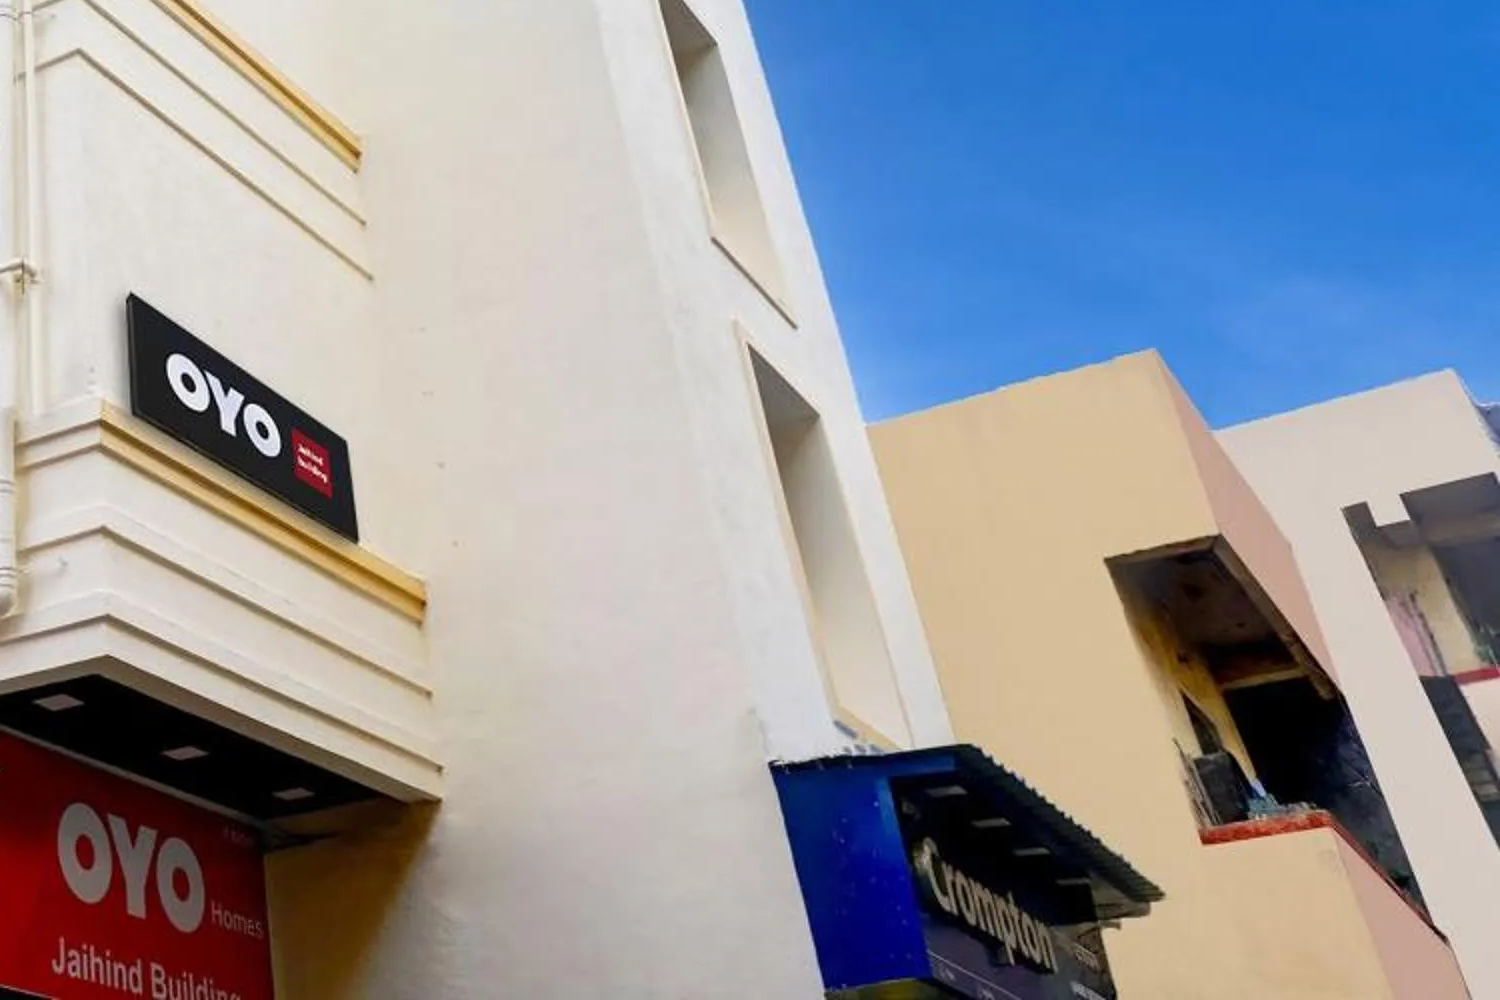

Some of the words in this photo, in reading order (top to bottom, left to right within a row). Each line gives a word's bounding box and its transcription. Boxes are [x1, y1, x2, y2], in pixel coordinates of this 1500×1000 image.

[166, 352, 282, 458] OYO
[57, 802, 205, 934] OYO
[211, 900, 264, 940] Homes
[920, 836, 1058, 974] Crompton
[52, 936, 144, 996] Jaihind
